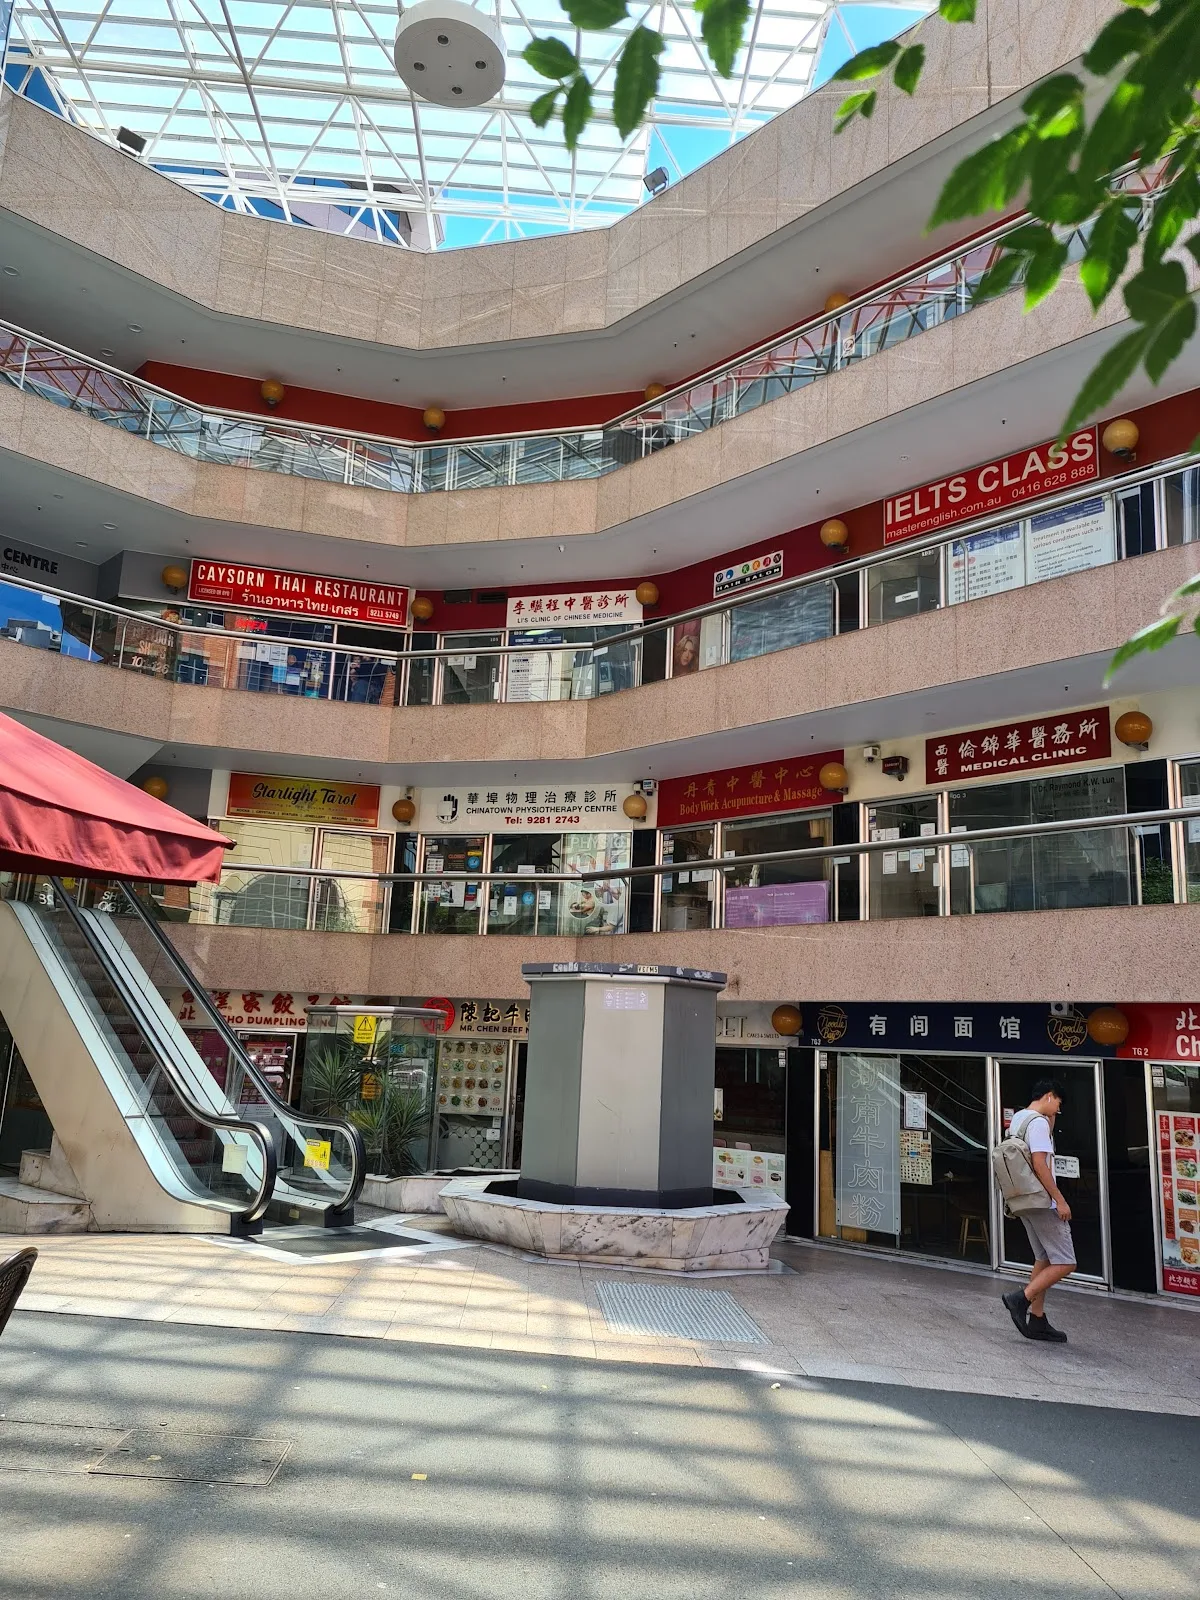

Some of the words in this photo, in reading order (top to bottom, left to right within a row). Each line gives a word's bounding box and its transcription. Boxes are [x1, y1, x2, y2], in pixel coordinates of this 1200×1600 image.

[886, 477, 968, 526] IELTS
[977, 432, 1095, 493] CLASS
[886, 496, 1002, 539] masterenglish.com.au
[1011, 481, 1041, 499] 0416
[1044, 473, 1067, 489] 628
[1071, 464, 1095, 480] 888
[3, 547, 59, 575] CENTRE
[197, 565, 265, 588] CAYSORN
[273, 574, 307, 593] THAI
[314, 580, 404, 607] RESTAURANT
[716, 580, 741, 592] HAIR
[745, 567, 780, 582] SALON
[517, 616, 529, 624] LI'S
[530, 615, 551, 623] CLINIC
[563, 613, 591, 621] CHINESE
[592, 611, 624, 620] MEDICINE
[957, 717, 1101, 760] 倫錦華醫務所
[960, 755, 1029, 773] MEDICAL
[1031, 745, 1088, 763] CLINIC
[252, 781, 318, 806] Starlight
[684, 765, 815, 799] 丹青中醫中心
[1049, 779, 1082, 792] Raymond
[465, 806, 513, 815] CHINATOWN
[515, 805, 583, 814] PHYSIOTHERAPY
[584, 804, 618, 813] CENTRE
[466, 789, 617, 805] 華埠物理治療診所
[721, 791, 773, 810] Acupuncture
[773, 790, 781, 802] &
[783, 786, 823, 802] Massage
[504, 816, 523, 825] Tel:
[526, 815, 552, 825] 9281
[555, 815, 580, 824] 2743
[247, 1016, 306, 1028] DUMPLING
[476, 1025, 500, 1033] CHEN
[501, 1026, 524, 1034] BEEF
[869, 1014, 1021, 1040] 有间面馆
[1132, 1047, 1143, 1056] TG
[1143, 1047, 1149, 1056] 2
